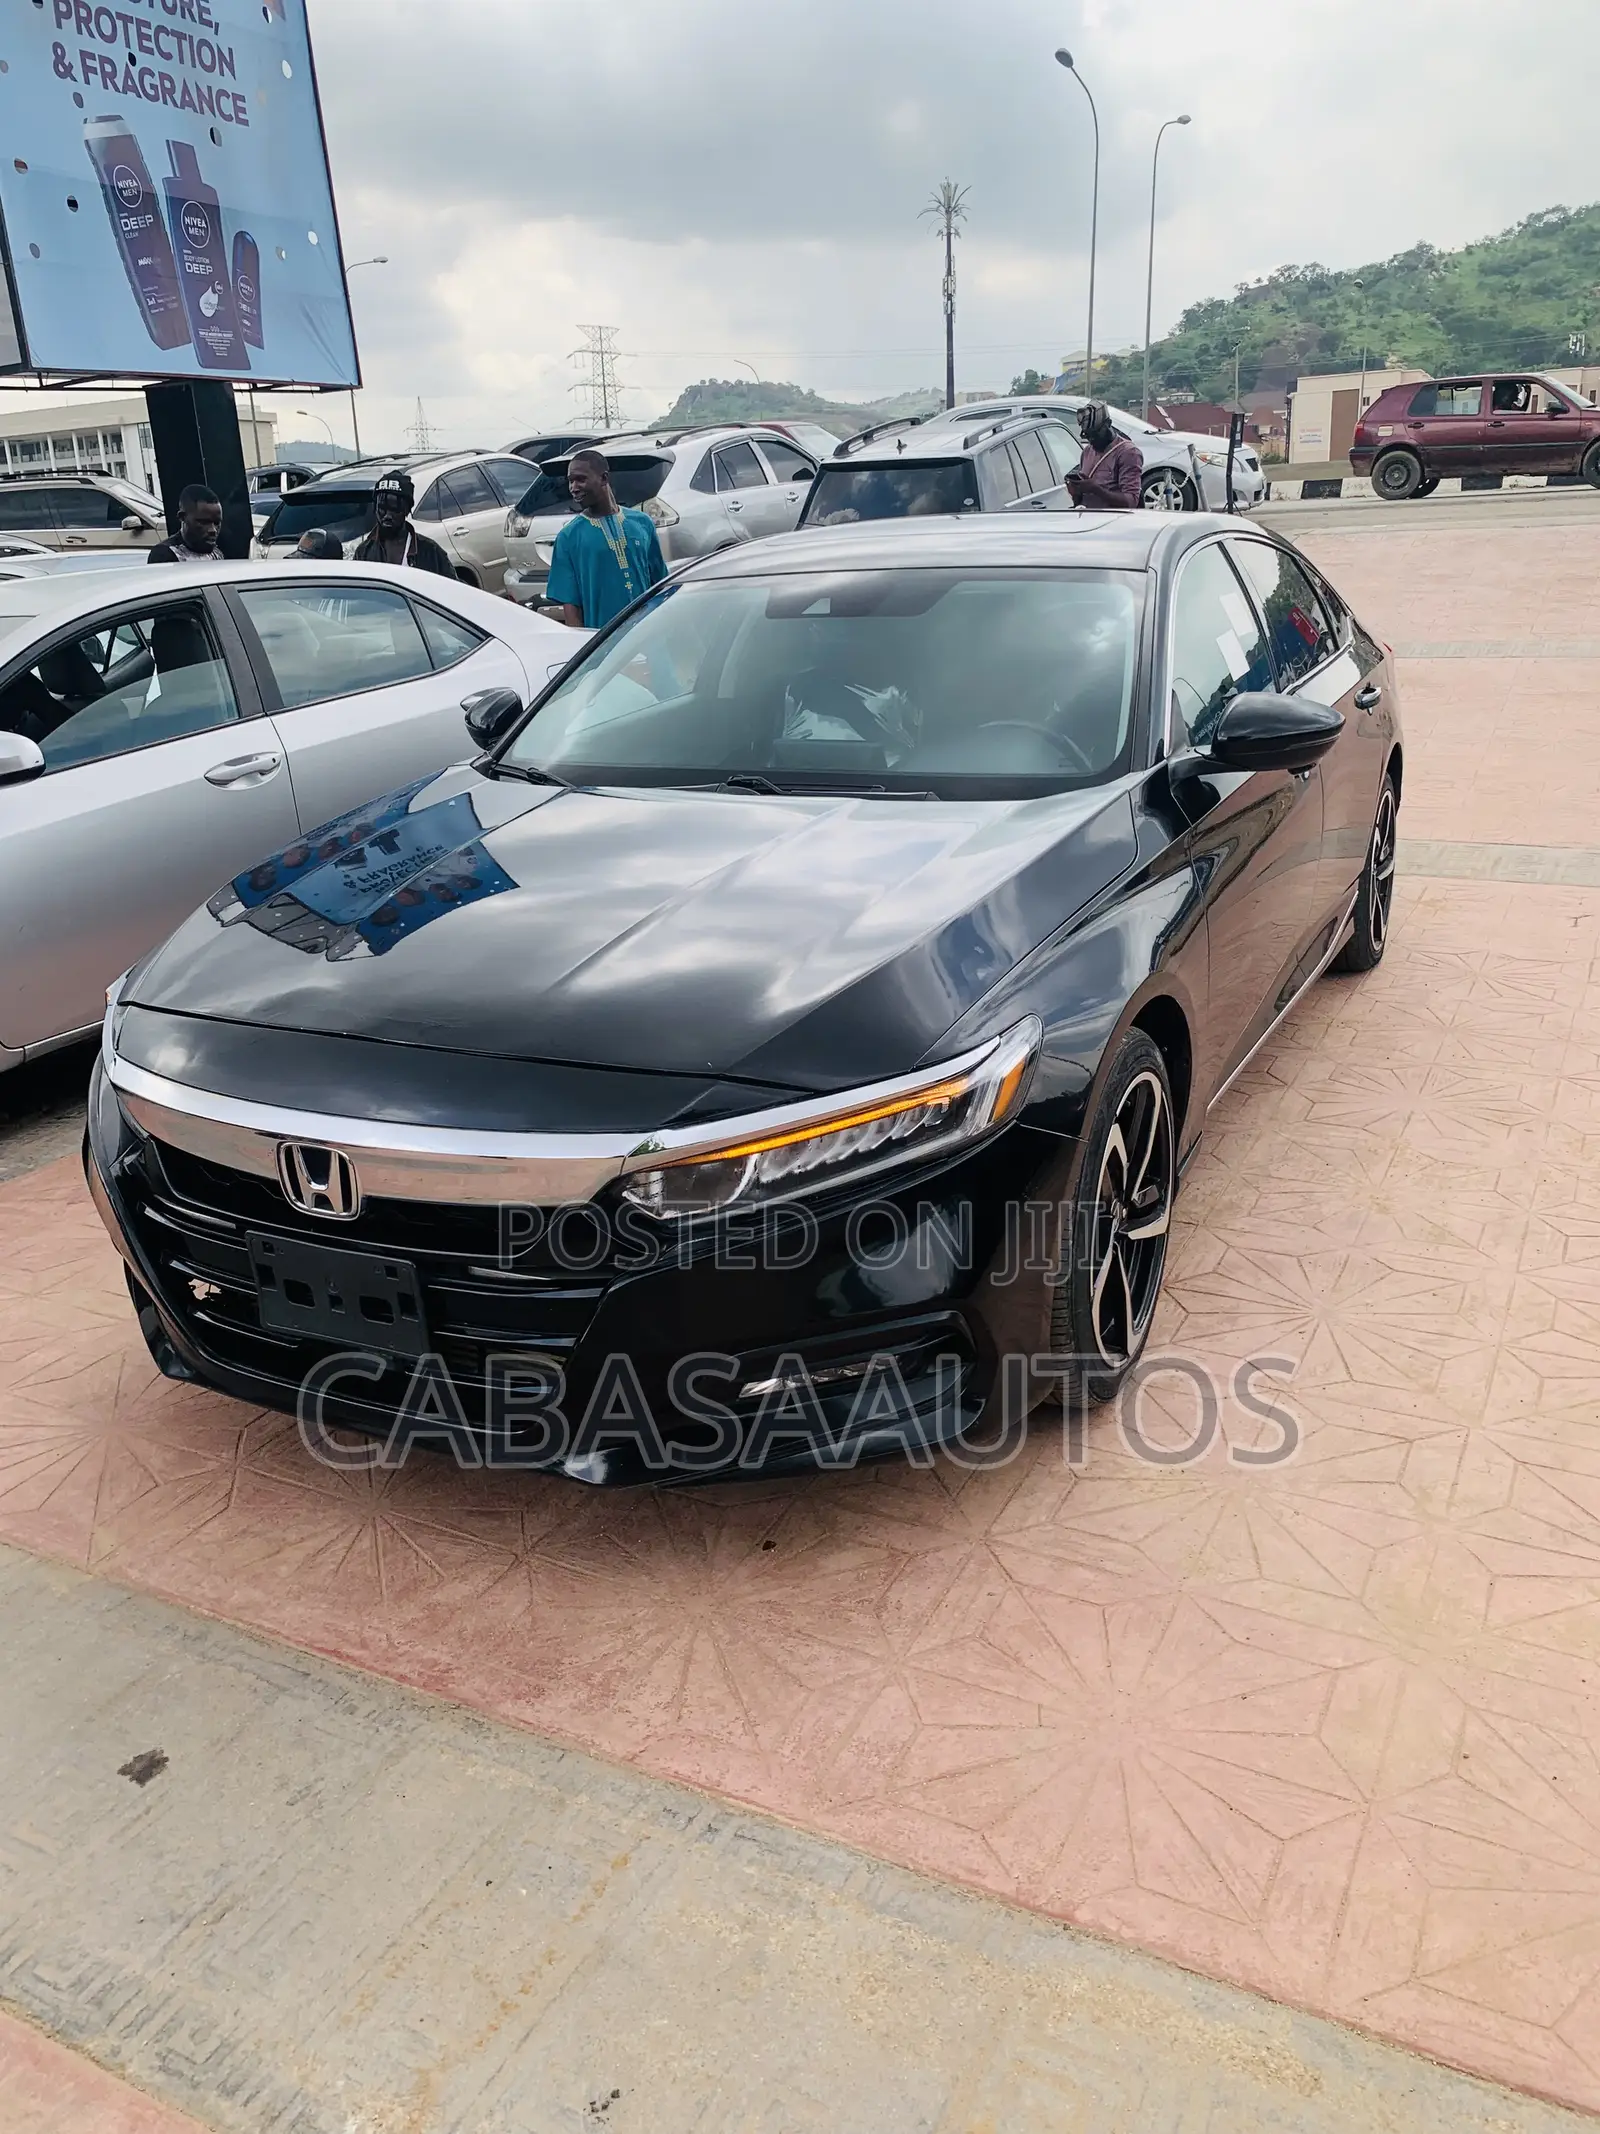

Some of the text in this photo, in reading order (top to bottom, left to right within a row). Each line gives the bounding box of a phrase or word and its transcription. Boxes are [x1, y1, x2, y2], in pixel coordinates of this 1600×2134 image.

[53, 0, 237, 81] PROTECTION
[52, 41, 250, 127] & FRAGRANCE
[117, 179, 138, 189] NIVEA
[122, 188, 138, 197] MEN
[120, 214, 154, 231] DEEP
[184, 215, 207, 228] NIVEA
[188, 226, 205, 237] MEN
[185, 262, 213, 275] DEEP
